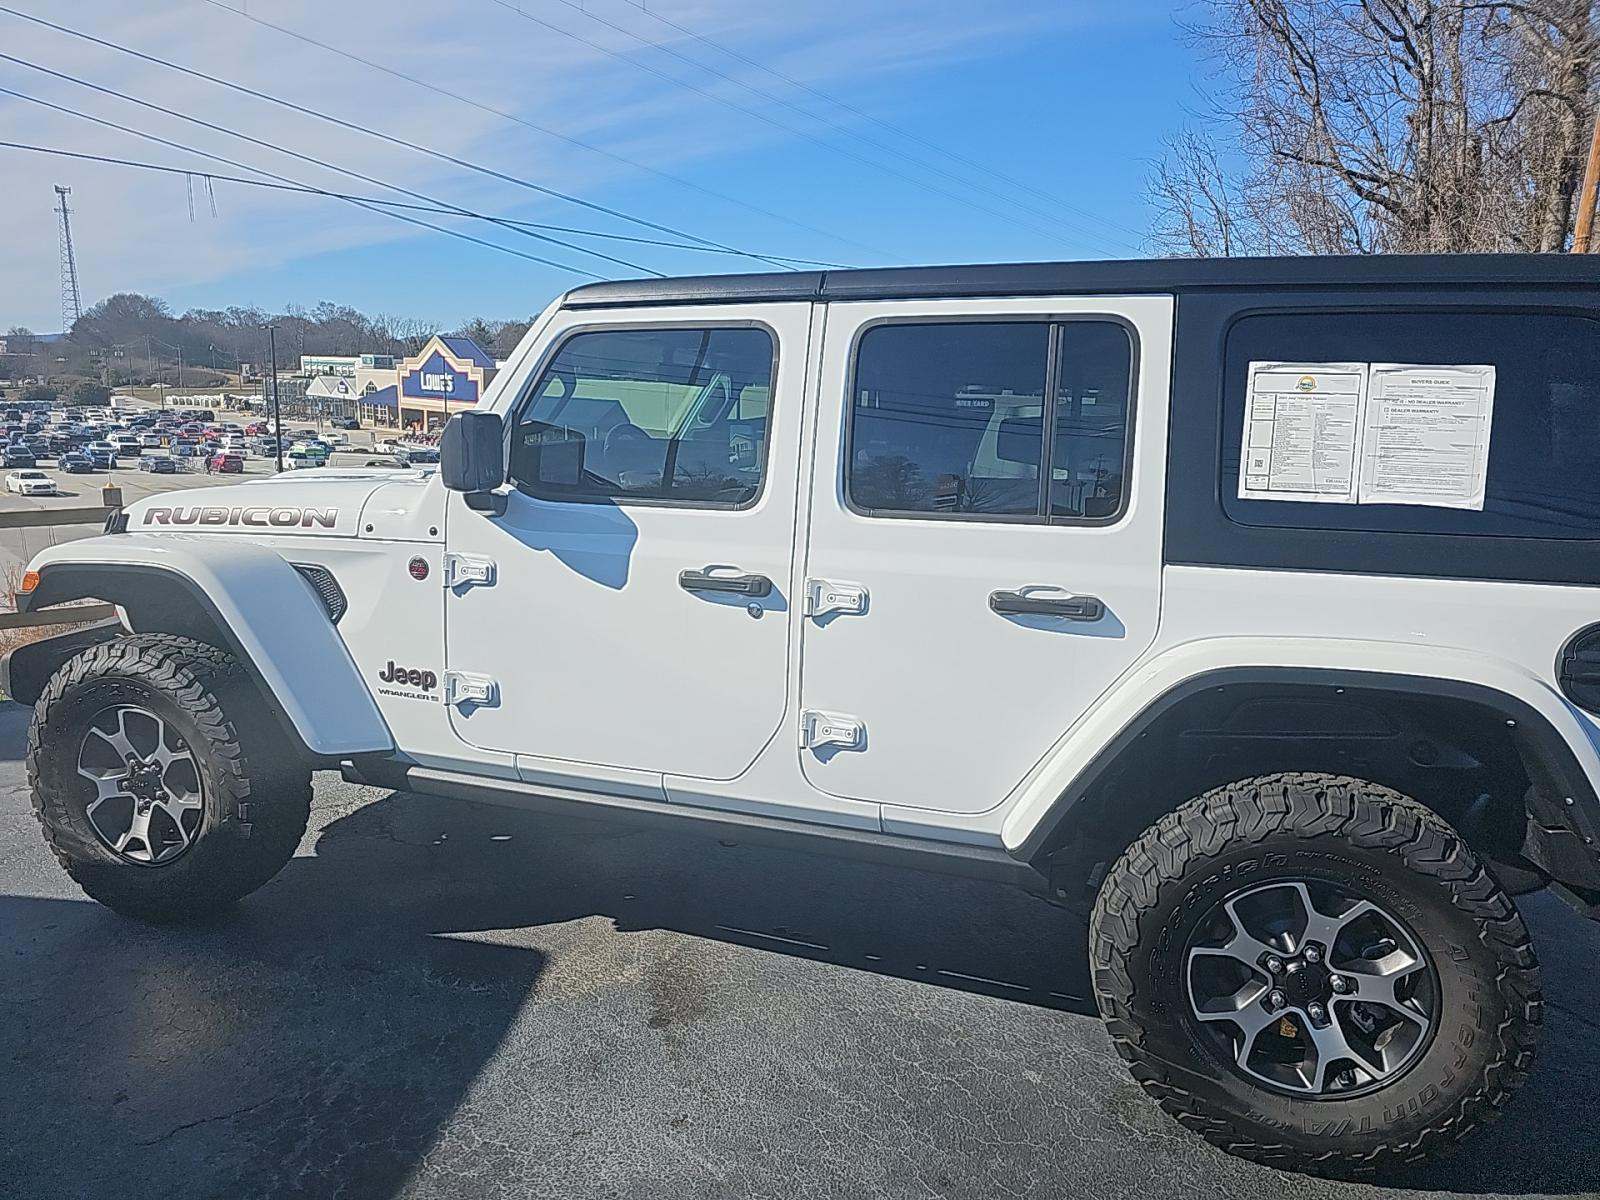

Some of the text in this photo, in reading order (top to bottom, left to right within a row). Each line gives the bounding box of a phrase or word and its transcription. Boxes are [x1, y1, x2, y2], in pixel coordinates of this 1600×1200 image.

[142, 507, 339, 528] RUBICON
[378, 660, 438, 692] Jeep
[378, 688, 430, 701] WRANGLER
